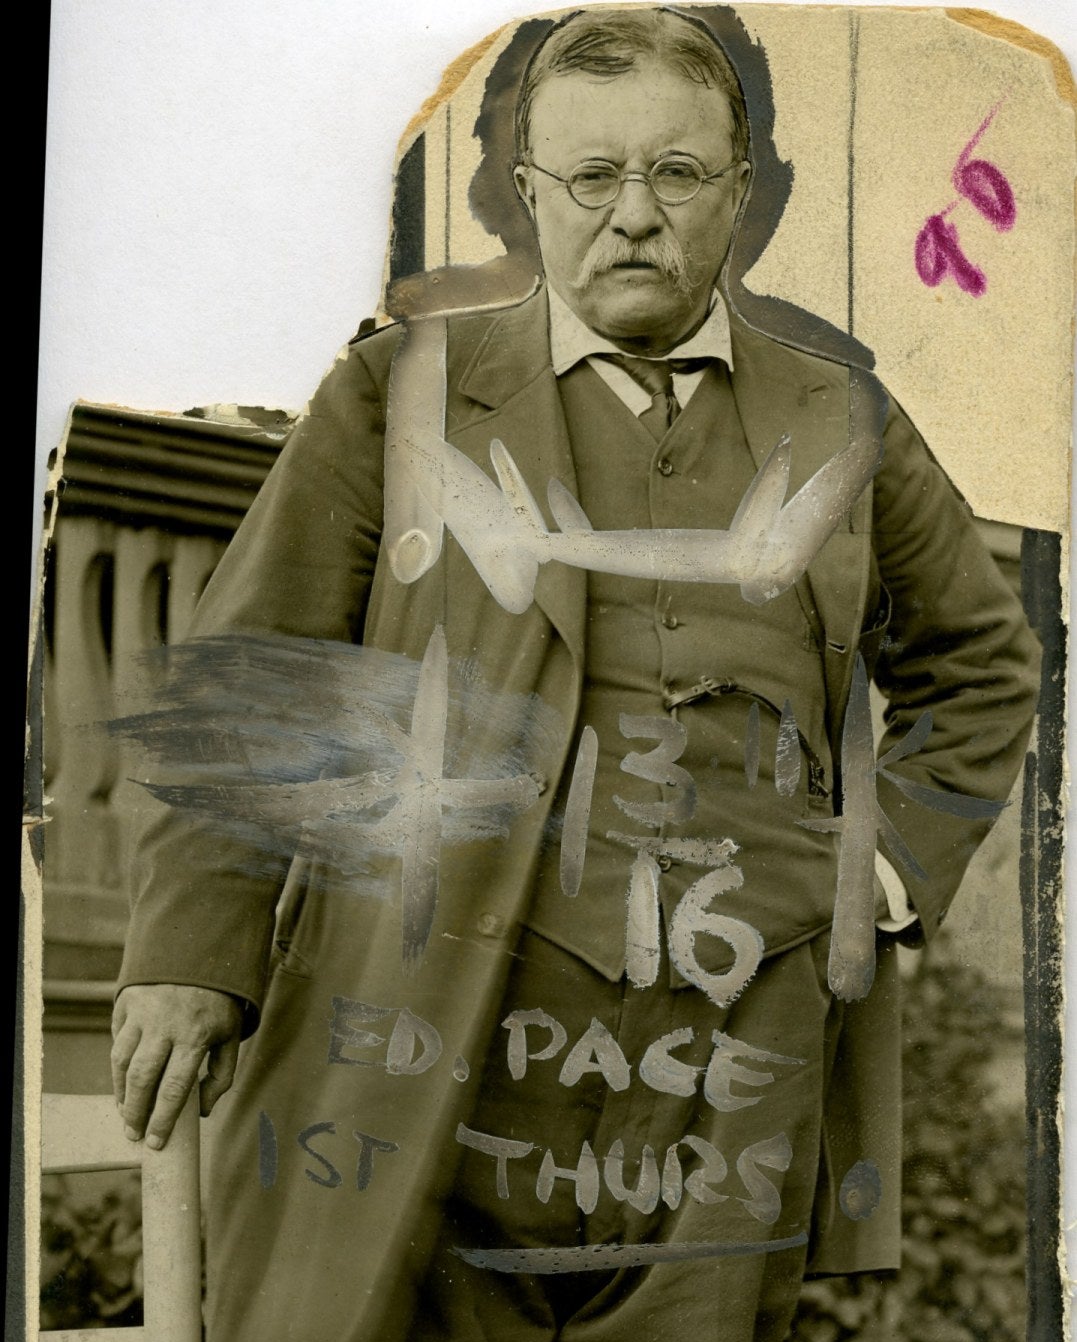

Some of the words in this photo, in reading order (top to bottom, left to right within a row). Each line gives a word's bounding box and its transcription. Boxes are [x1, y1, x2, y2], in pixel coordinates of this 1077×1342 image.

[327, 996, 471, 1084] ED.
[500, 1007, 808, 1112] PACE
[259, 1110, 399, 1190] 1ST
